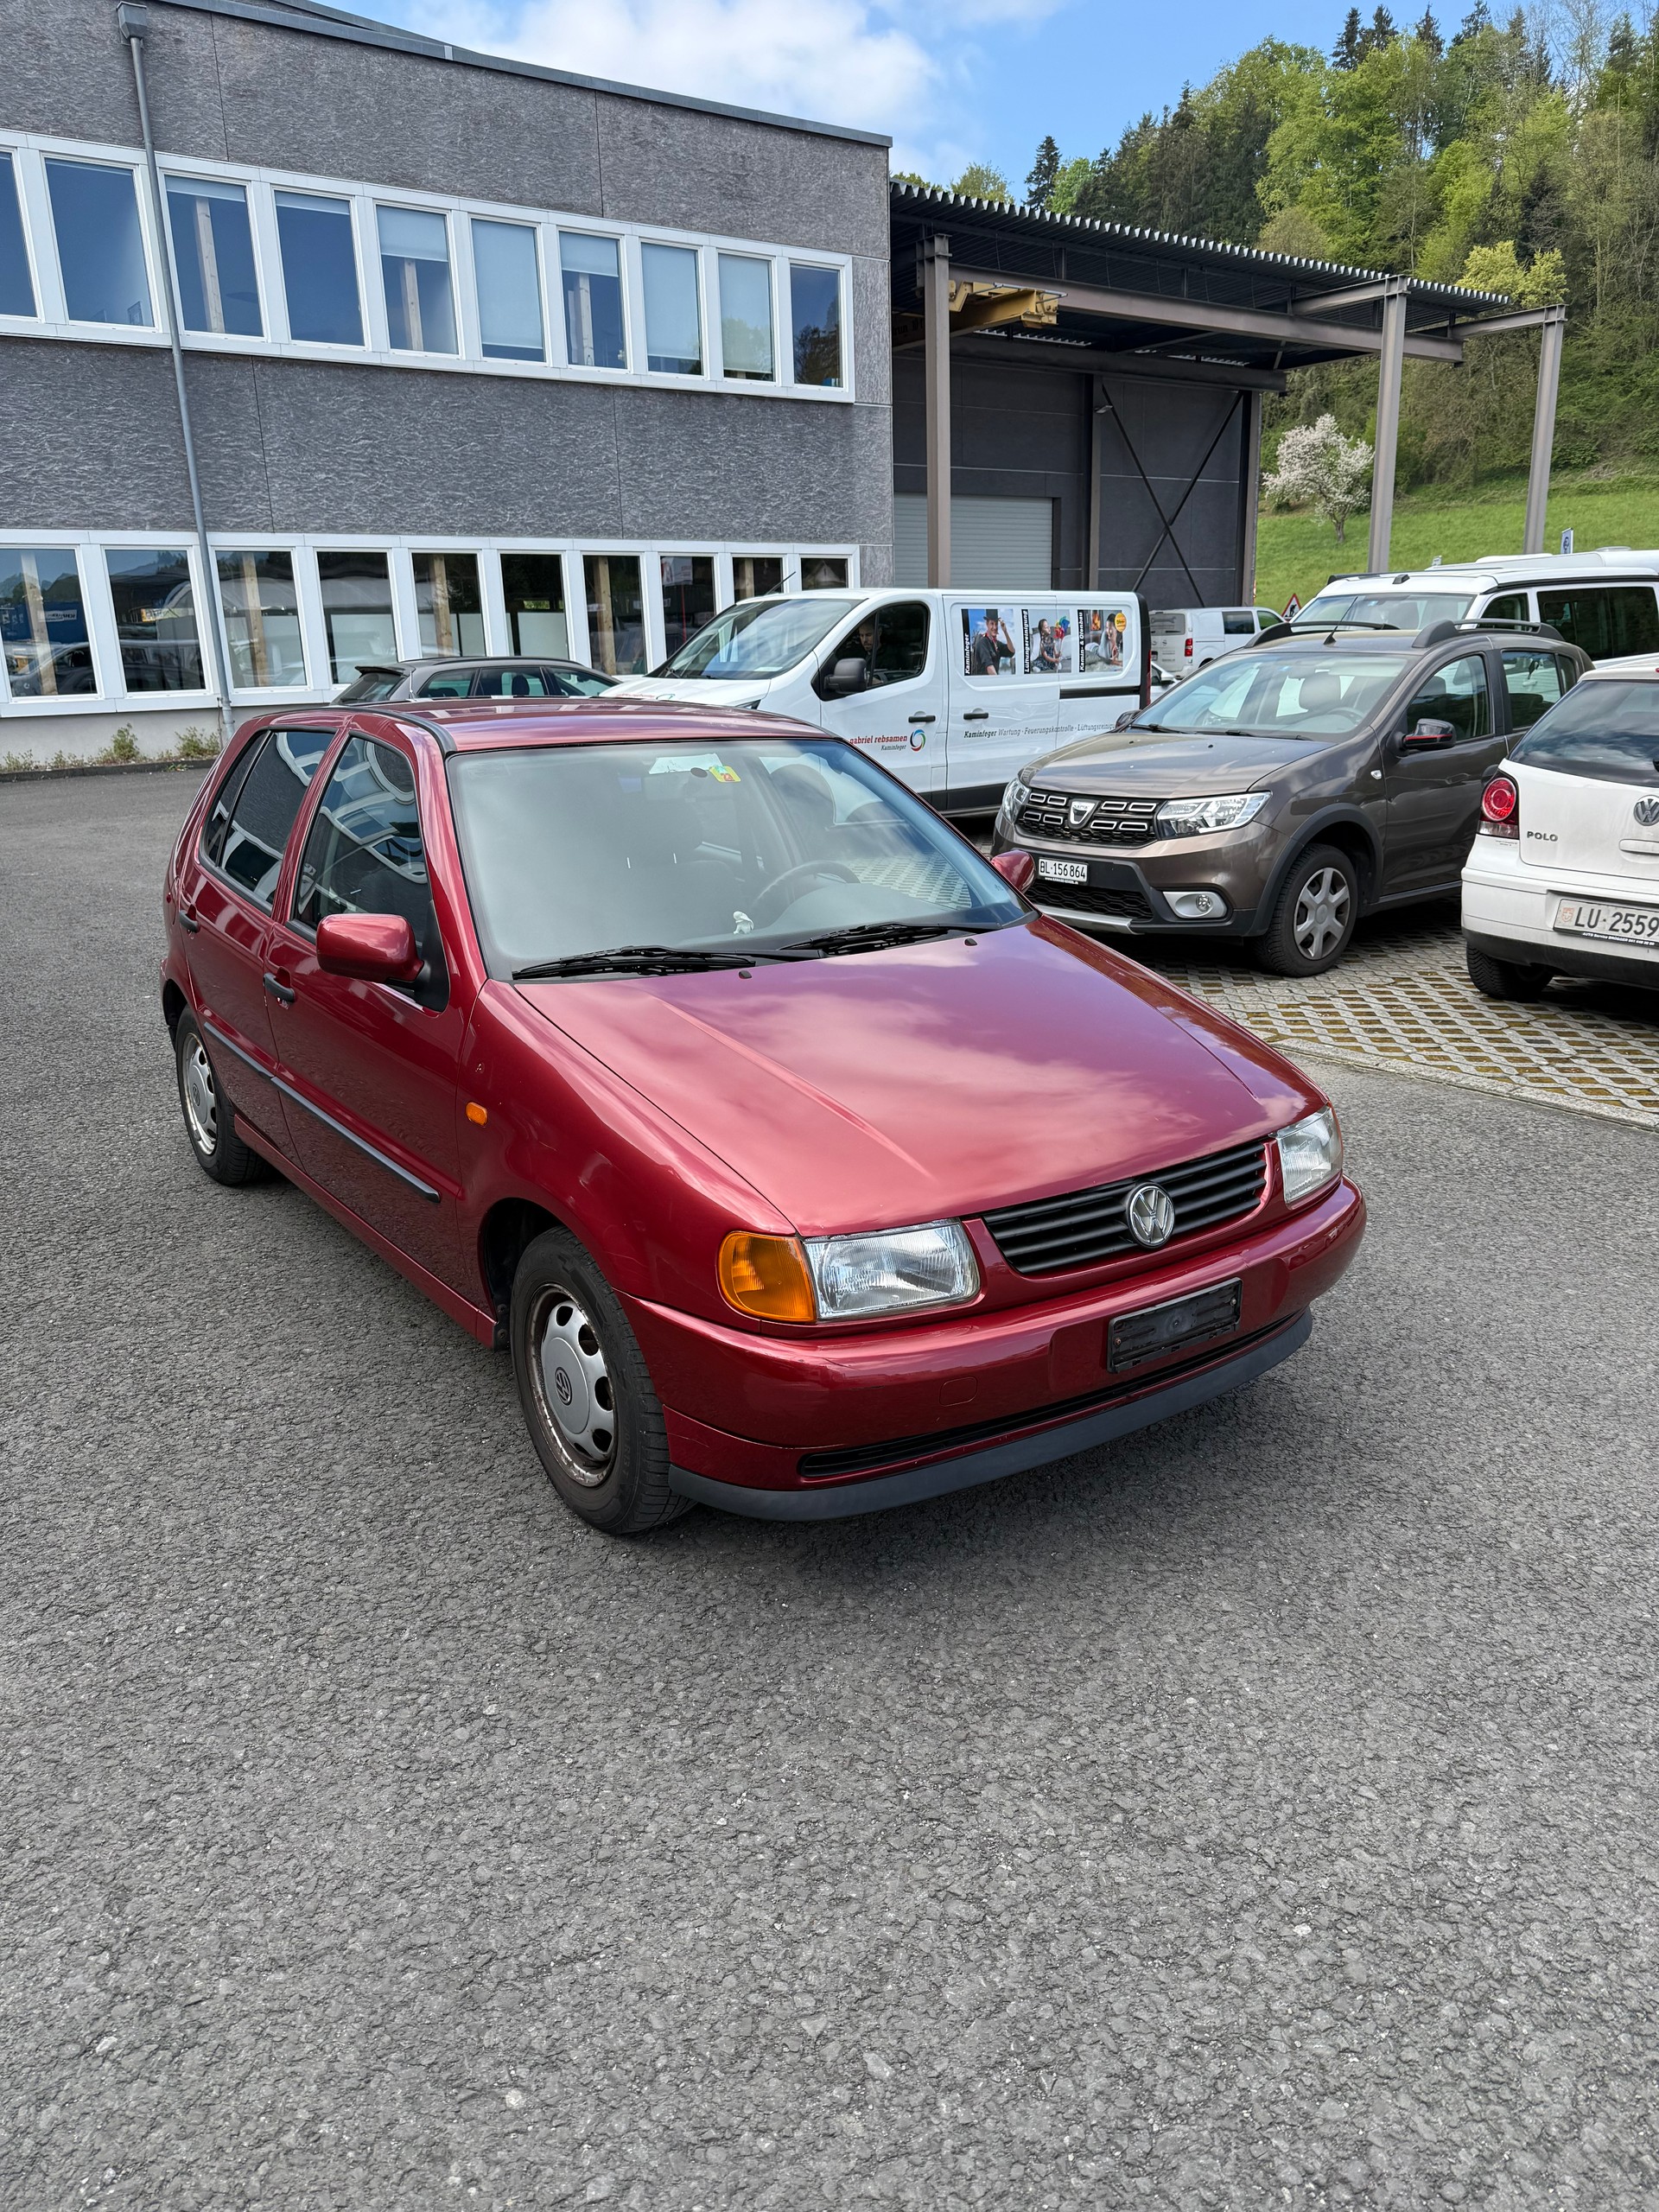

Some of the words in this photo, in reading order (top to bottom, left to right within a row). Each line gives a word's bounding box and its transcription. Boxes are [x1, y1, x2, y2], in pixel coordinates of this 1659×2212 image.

[963, 729, 996, 739] Kaminfeger
[998, 728, 1021, 737] Wartung
[1024, 725, 1074, 735] Feuerungskontrolle
[849, 735, 874, 745] gabriel
[874, 734, 908, 743] rebsamen
[1526, 830, 1559, 842] POLO
